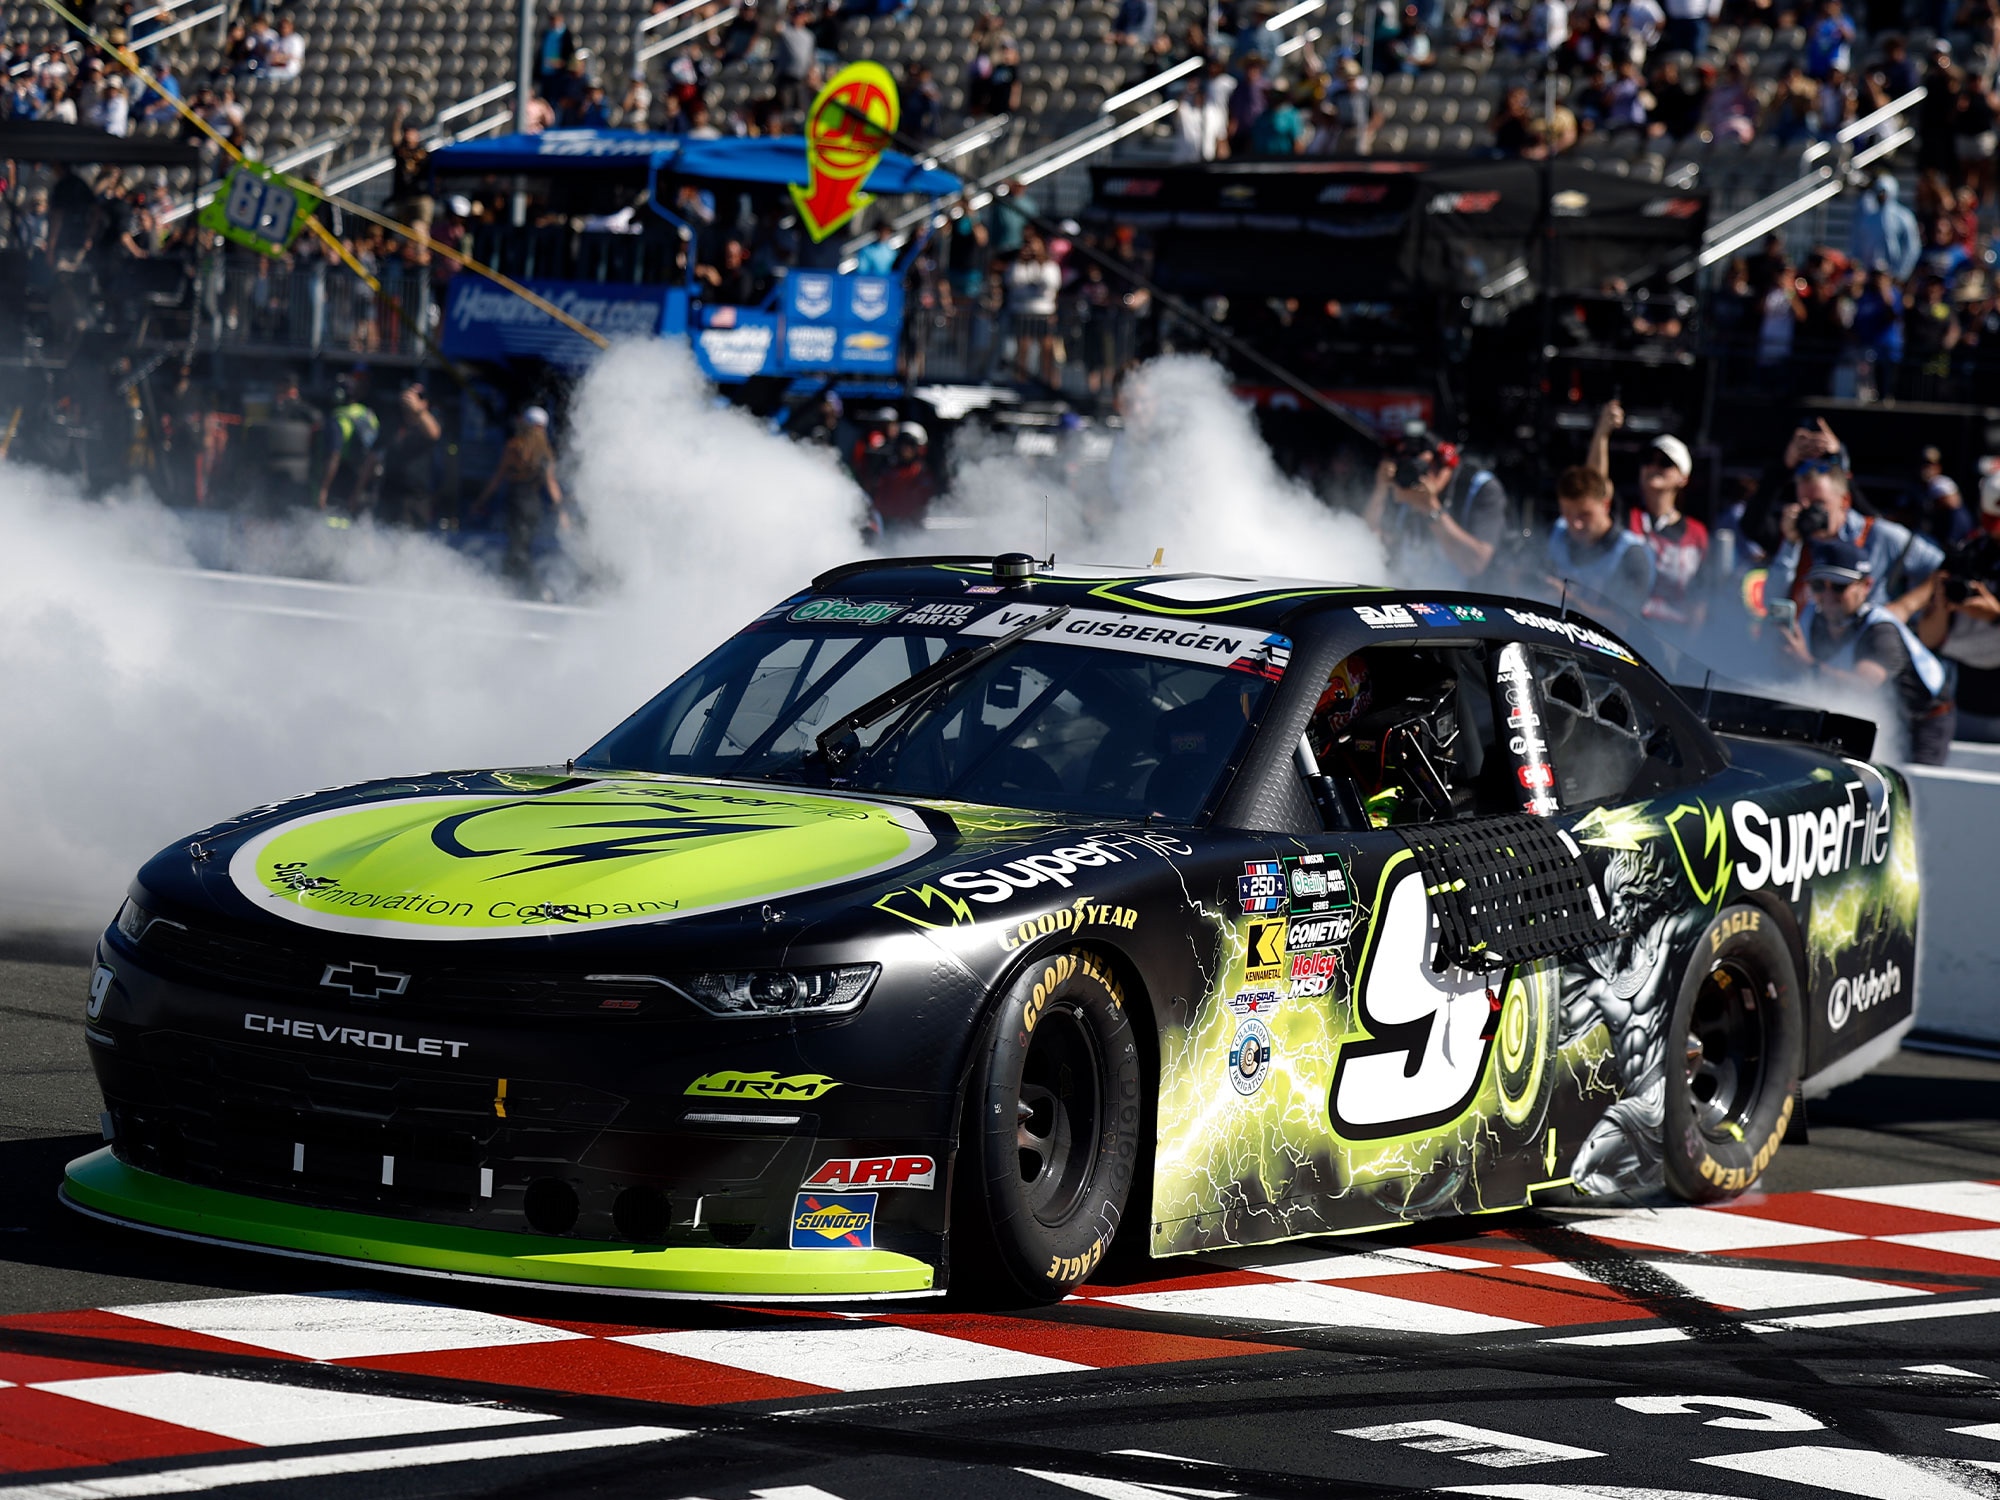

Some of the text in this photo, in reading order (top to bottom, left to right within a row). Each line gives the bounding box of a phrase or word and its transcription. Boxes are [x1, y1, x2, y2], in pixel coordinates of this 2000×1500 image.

[790, 600, 898, 624] O'Reilly
[897, 613, 968, 627] PARTS
[916, 603, 975, 615] AUTO
[1065, 619, 1242, 655] GISBERGEN
[1731, 780, 1890, 903] SuperFile
[938, 830, 1193, 903] SuperFile
[1327, 869, 1342, 881] AUTO
[1250, 876, 1275, 897] 250
[1327, 880, 1346, 893] PARTS
[308, 882, 472, 917] Innovation
[1312, 901, 1330, 911] SERIES
[1288, 919, 1350, 945] COMETIC
[1710, 911, 1761, 954] EAGLE
[1291, 942, 1317, 950] GASKET
[1245, 969, 1282, 983] KENNAMETAL
[1290, 953, 1336, 979] Holley
[87, 965, 114, 1019] 9
[1236, 991, 1276, 1004] FIVE STAR
[1288, 977, 1328, 998] MSD
[1335, 870, 1505, 1126] 9
[244, 1013, 469, 1058] CHEVROLET
[1234, 1022, 1267, 1047] CHAMPION
[696, 1079, 819, 1100] JRM
[1231, 1064, 1266, 1092] IRRIGATION
[807, 1156, 935, 1184] ARP
[798, 1214, 869, 1229] SUNOCO
[1046, 1237, 1102, 1272] EAGLE
